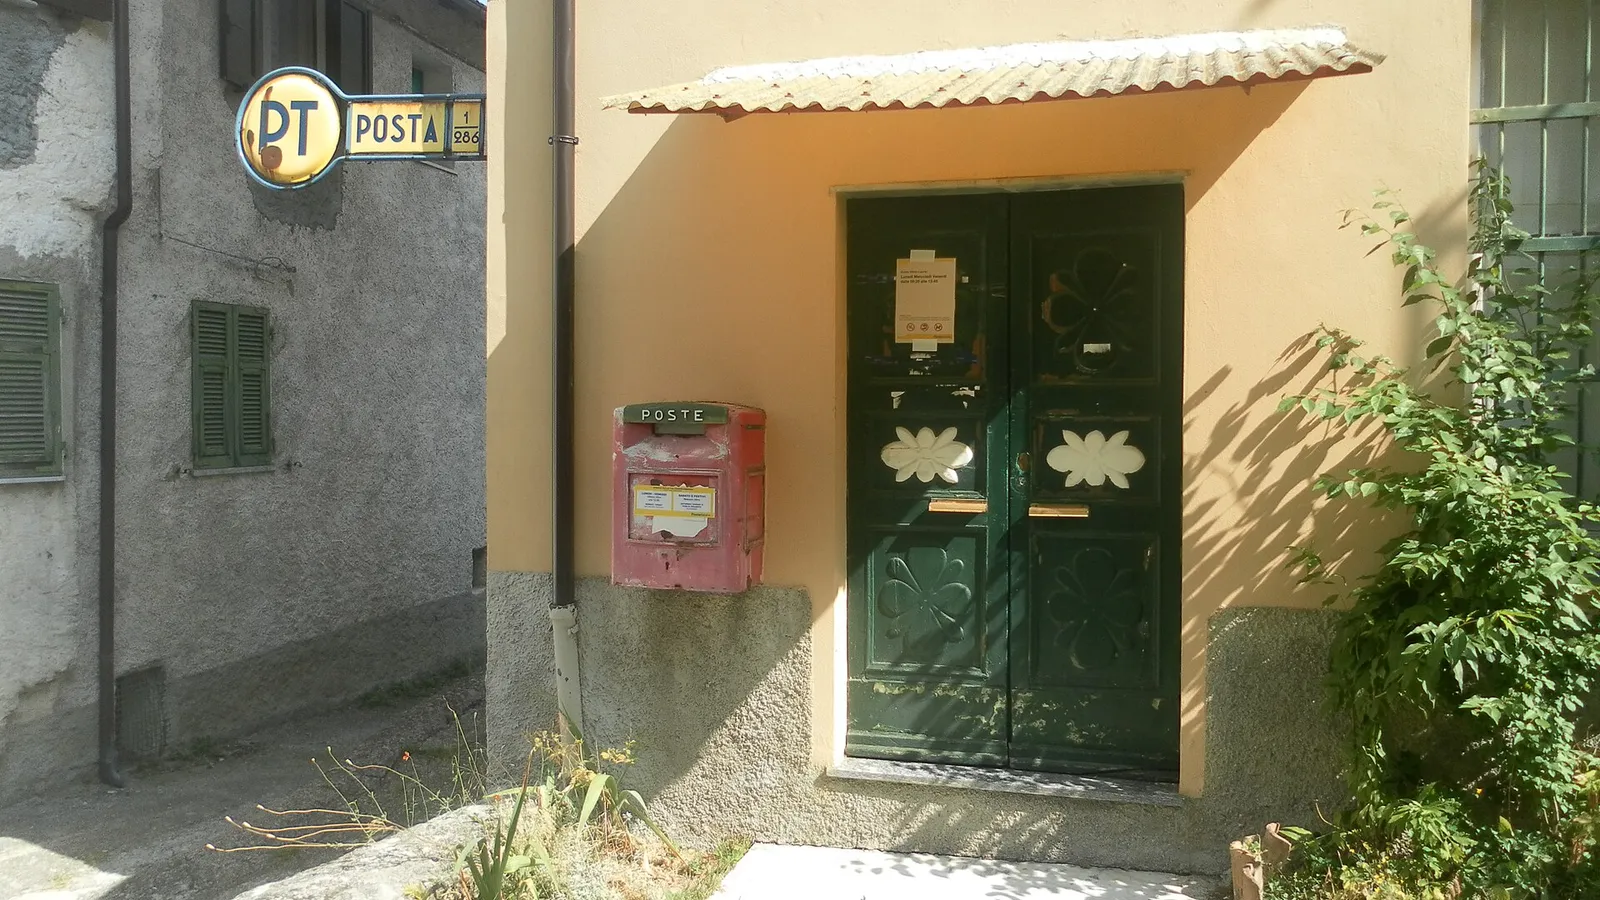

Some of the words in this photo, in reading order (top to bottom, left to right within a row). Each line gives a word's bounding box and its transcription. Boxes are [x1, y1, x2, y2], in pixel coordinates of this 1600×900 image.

[463, 111, 470, 125] 1
[258, 100, 319, 157] PT
[356, 113, 438, 144] POSTA
[453, 130, 480, 145] 286
[641, 409, 704, 421] POSTE
